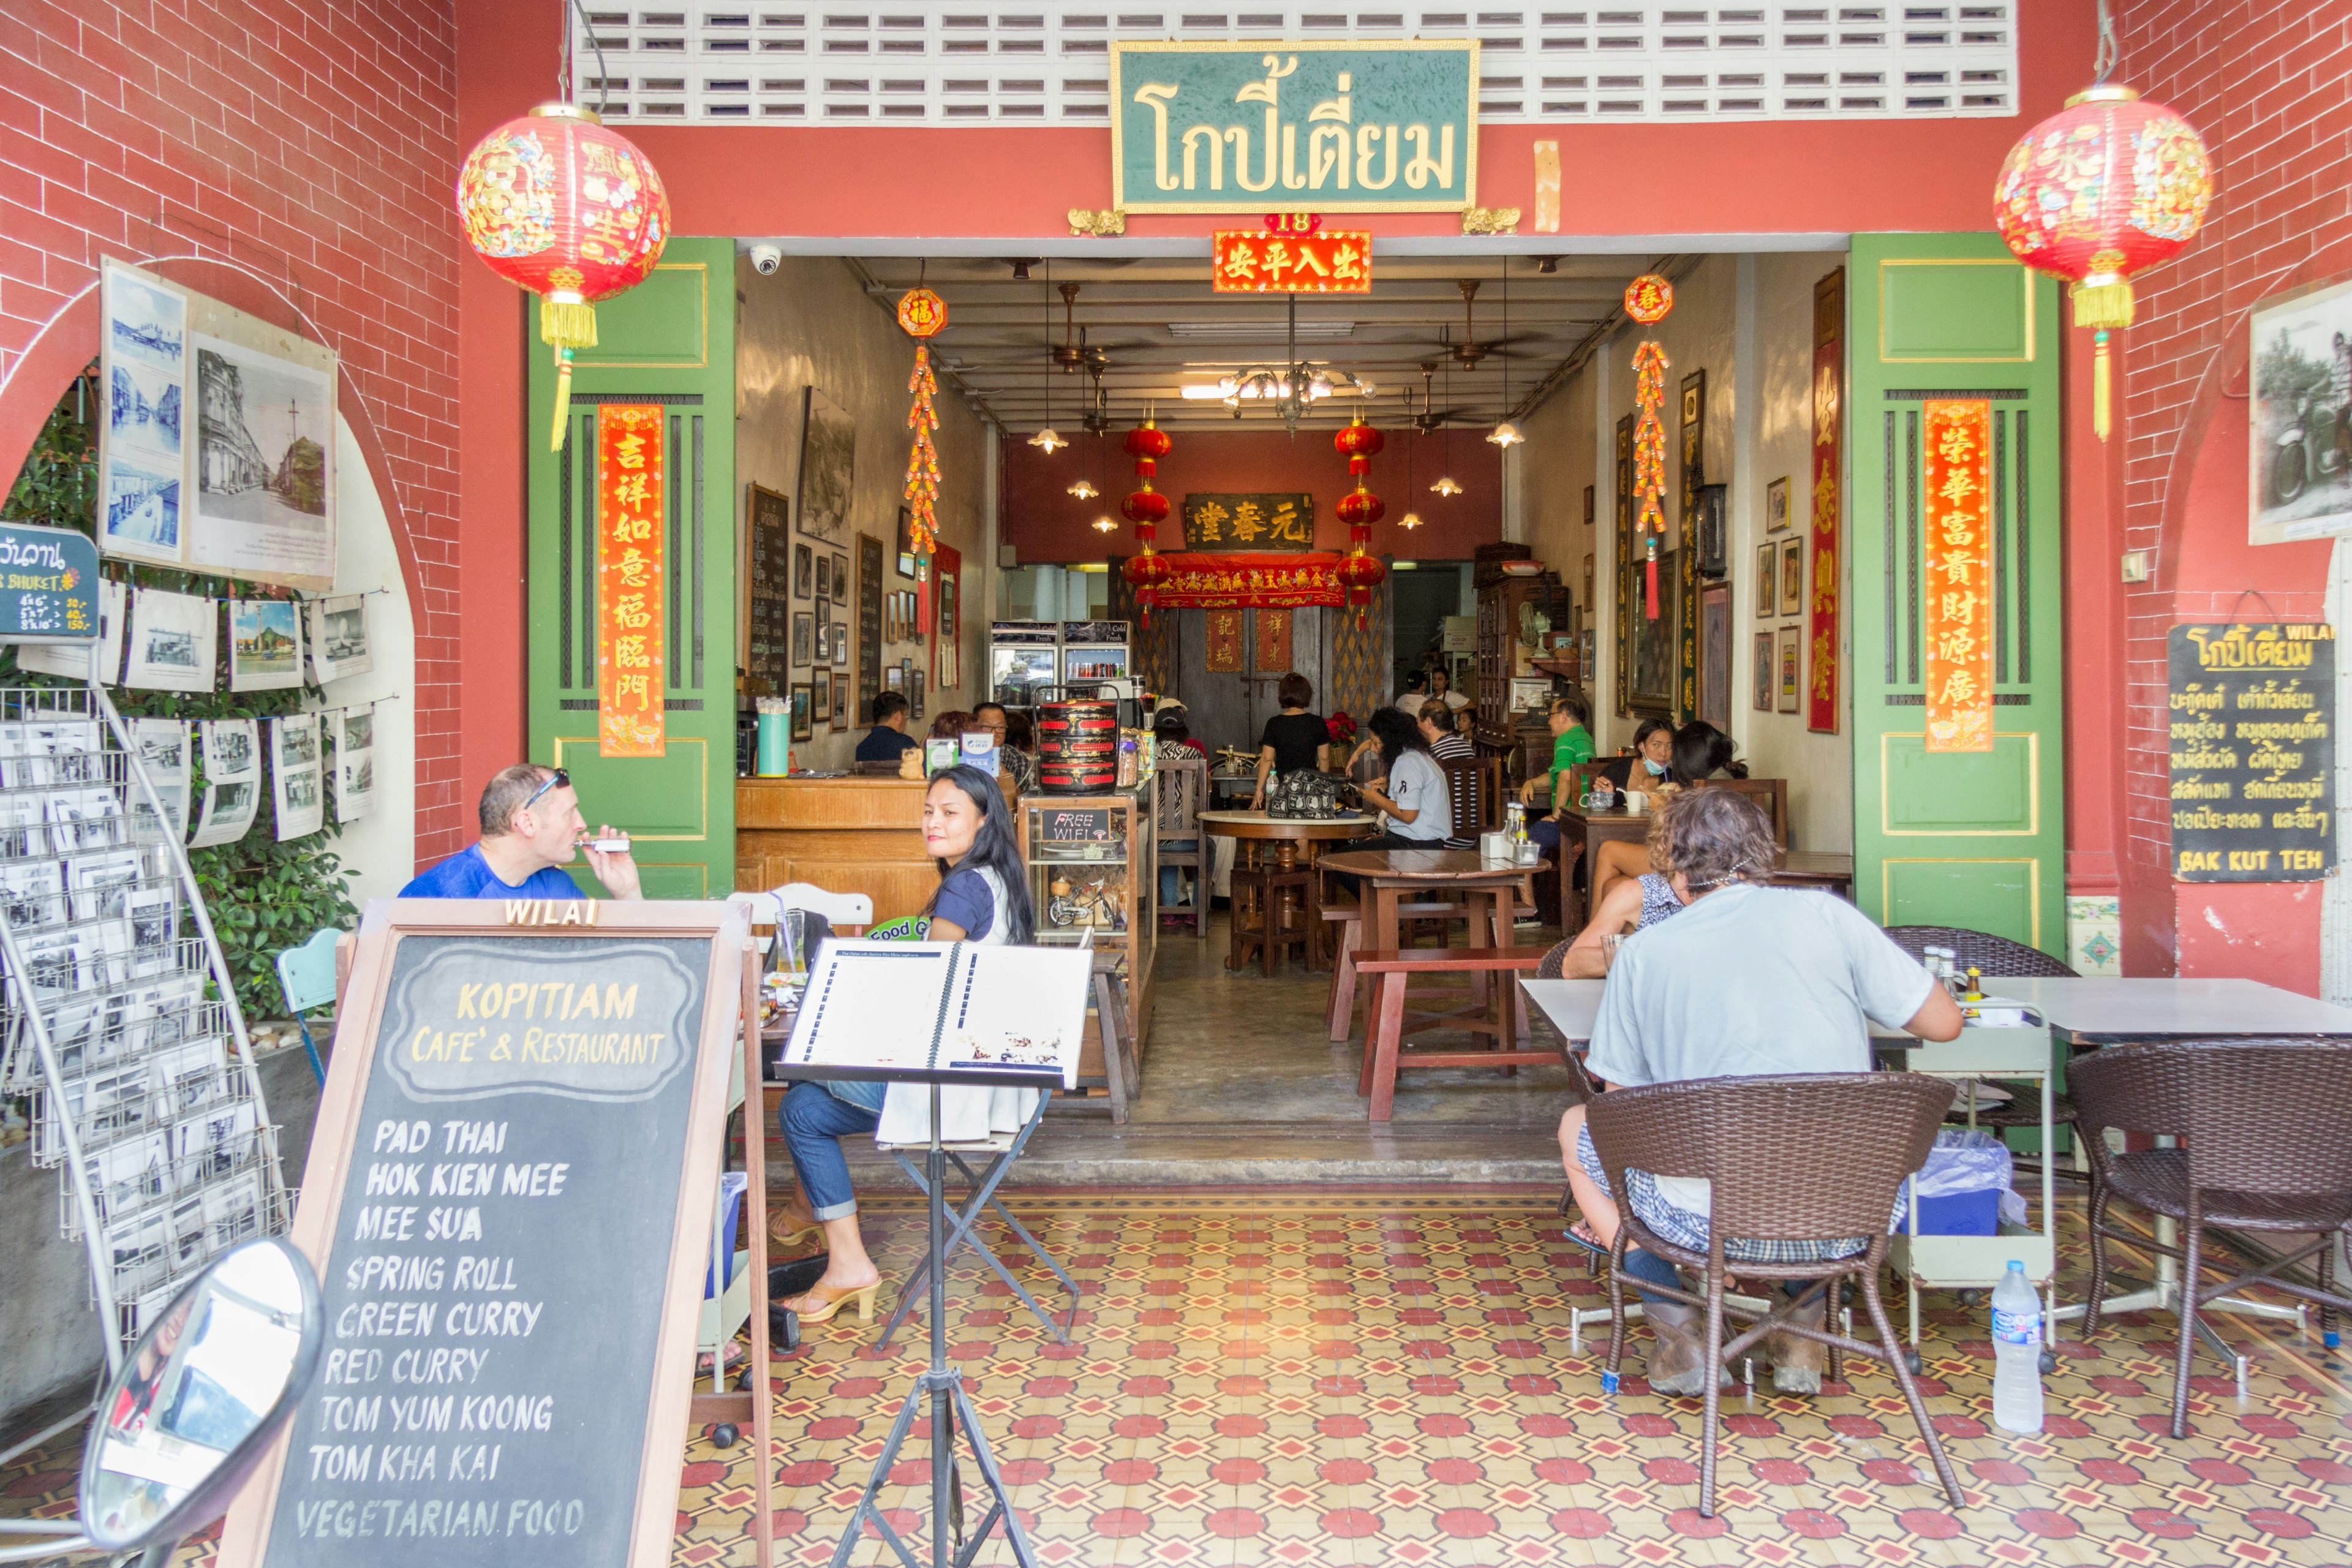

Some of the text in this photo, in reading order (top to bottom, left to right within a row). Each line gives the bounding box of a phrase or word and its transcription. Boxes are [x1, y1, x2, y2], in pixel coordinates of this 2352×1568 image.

[1134, 55, 1454, 192] โกปี้เตี่ยม
[1277, 213, 1310, 232] 18
[909, 299, 933, 323] 福
[1638, 284, 1662, 310] 春
[609, 432, 652, 713] 吉祥如意福臨門
[1936, 427, 1980, 709] 榮華富貴財源廣
[1054, 828, 1088, 841] WIFI
[1055, 813, 1093, 827] FREE
[2179, 850, 2324, 872] BAK KUT TEH
[504, 897, 598, 927] WILAI
[456, 982, 638, 1021] KOPITIAM
[489, 1032, 513, 1062] &
[373, 1119, 509, 1155] PAD THAI
[365, 1162, 570, 1197] HOK KIEN MEE
[354, 1205, 483, 1243] MEE SUA
[346, 1255, 518, 1292] SPRING ROLL
[336, 1300, 544, 1339] GREEN CURRY
[323, 1347, 491, 1385] RED CURRY
[320, 1394, 554, 1433] TOM YUM KOONG
[309, 1444, 502, 1482] TOM KHA KAI
[296, 1498, 586, 1539] VEGETARIAN FOOD
